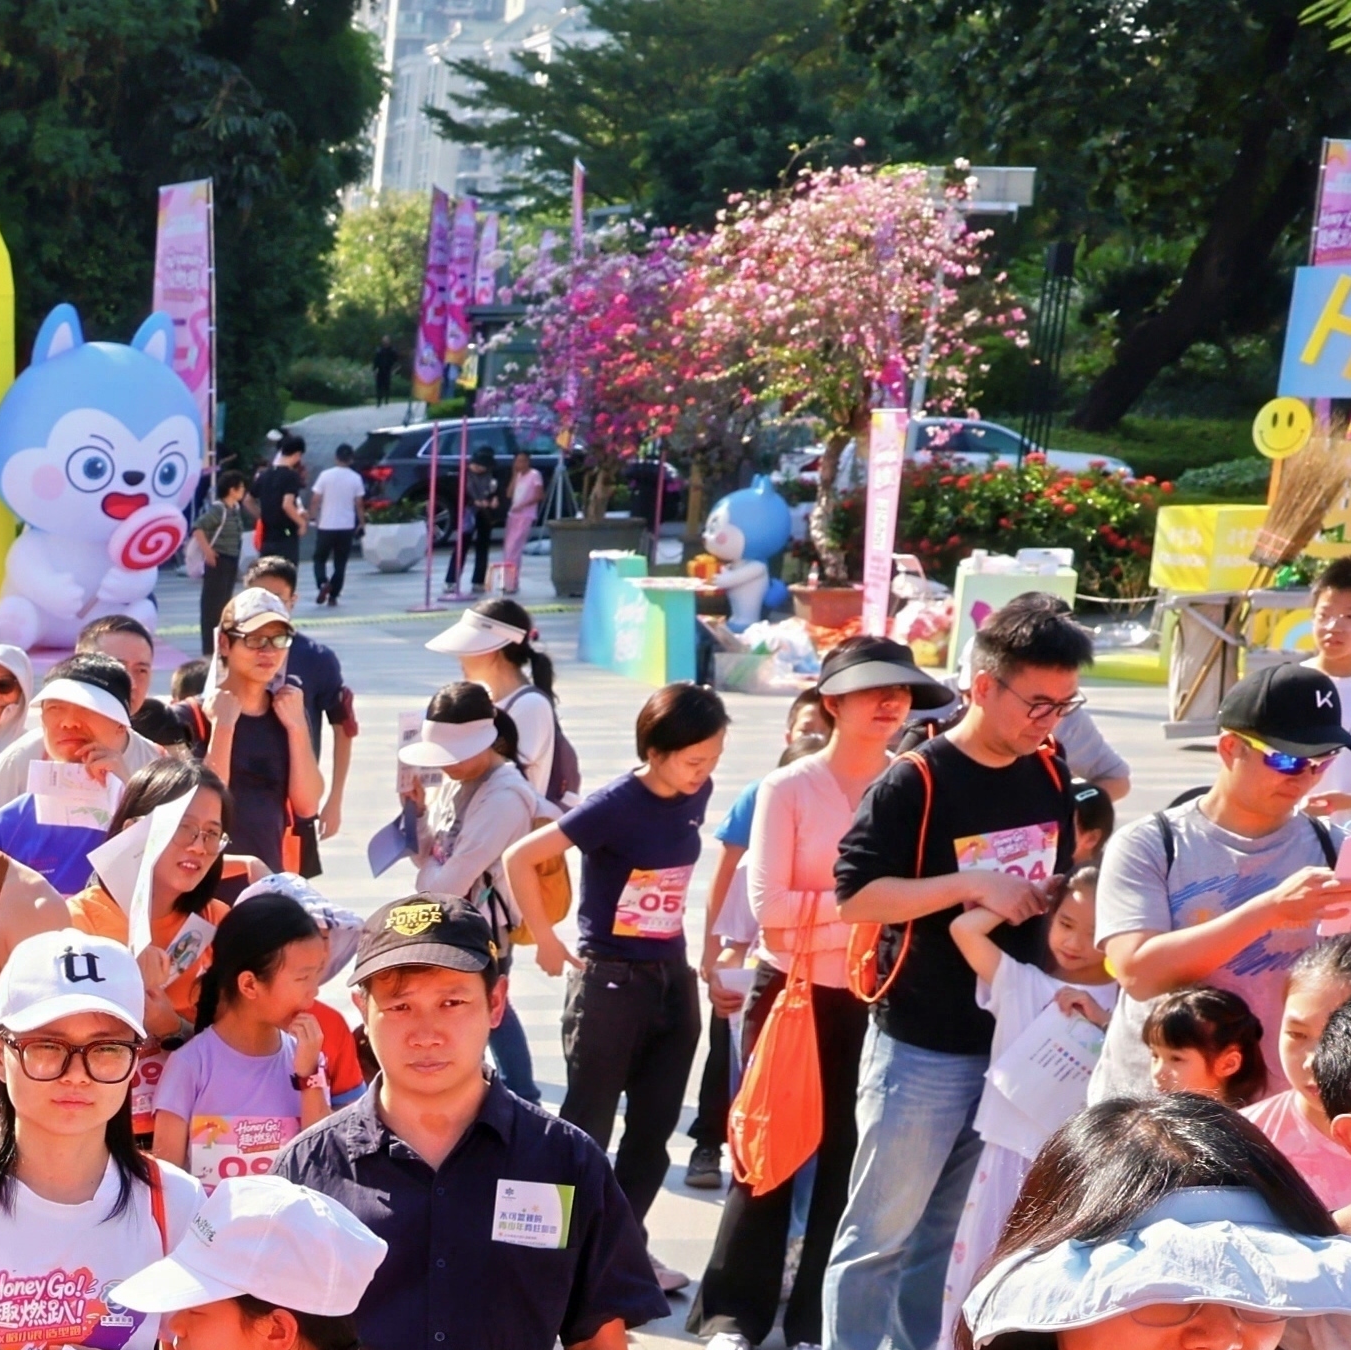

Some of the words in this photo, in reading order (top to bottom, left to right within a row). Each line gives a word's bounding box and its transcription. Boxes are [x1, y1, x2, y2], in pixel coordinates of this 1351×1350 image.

[383, 910, 443, 930] FORCE
[235, 1120, 265, 1136] Honey
[265, 1119, 282, 1132] Go!
[47, 1272, 83, 1299] Go!
